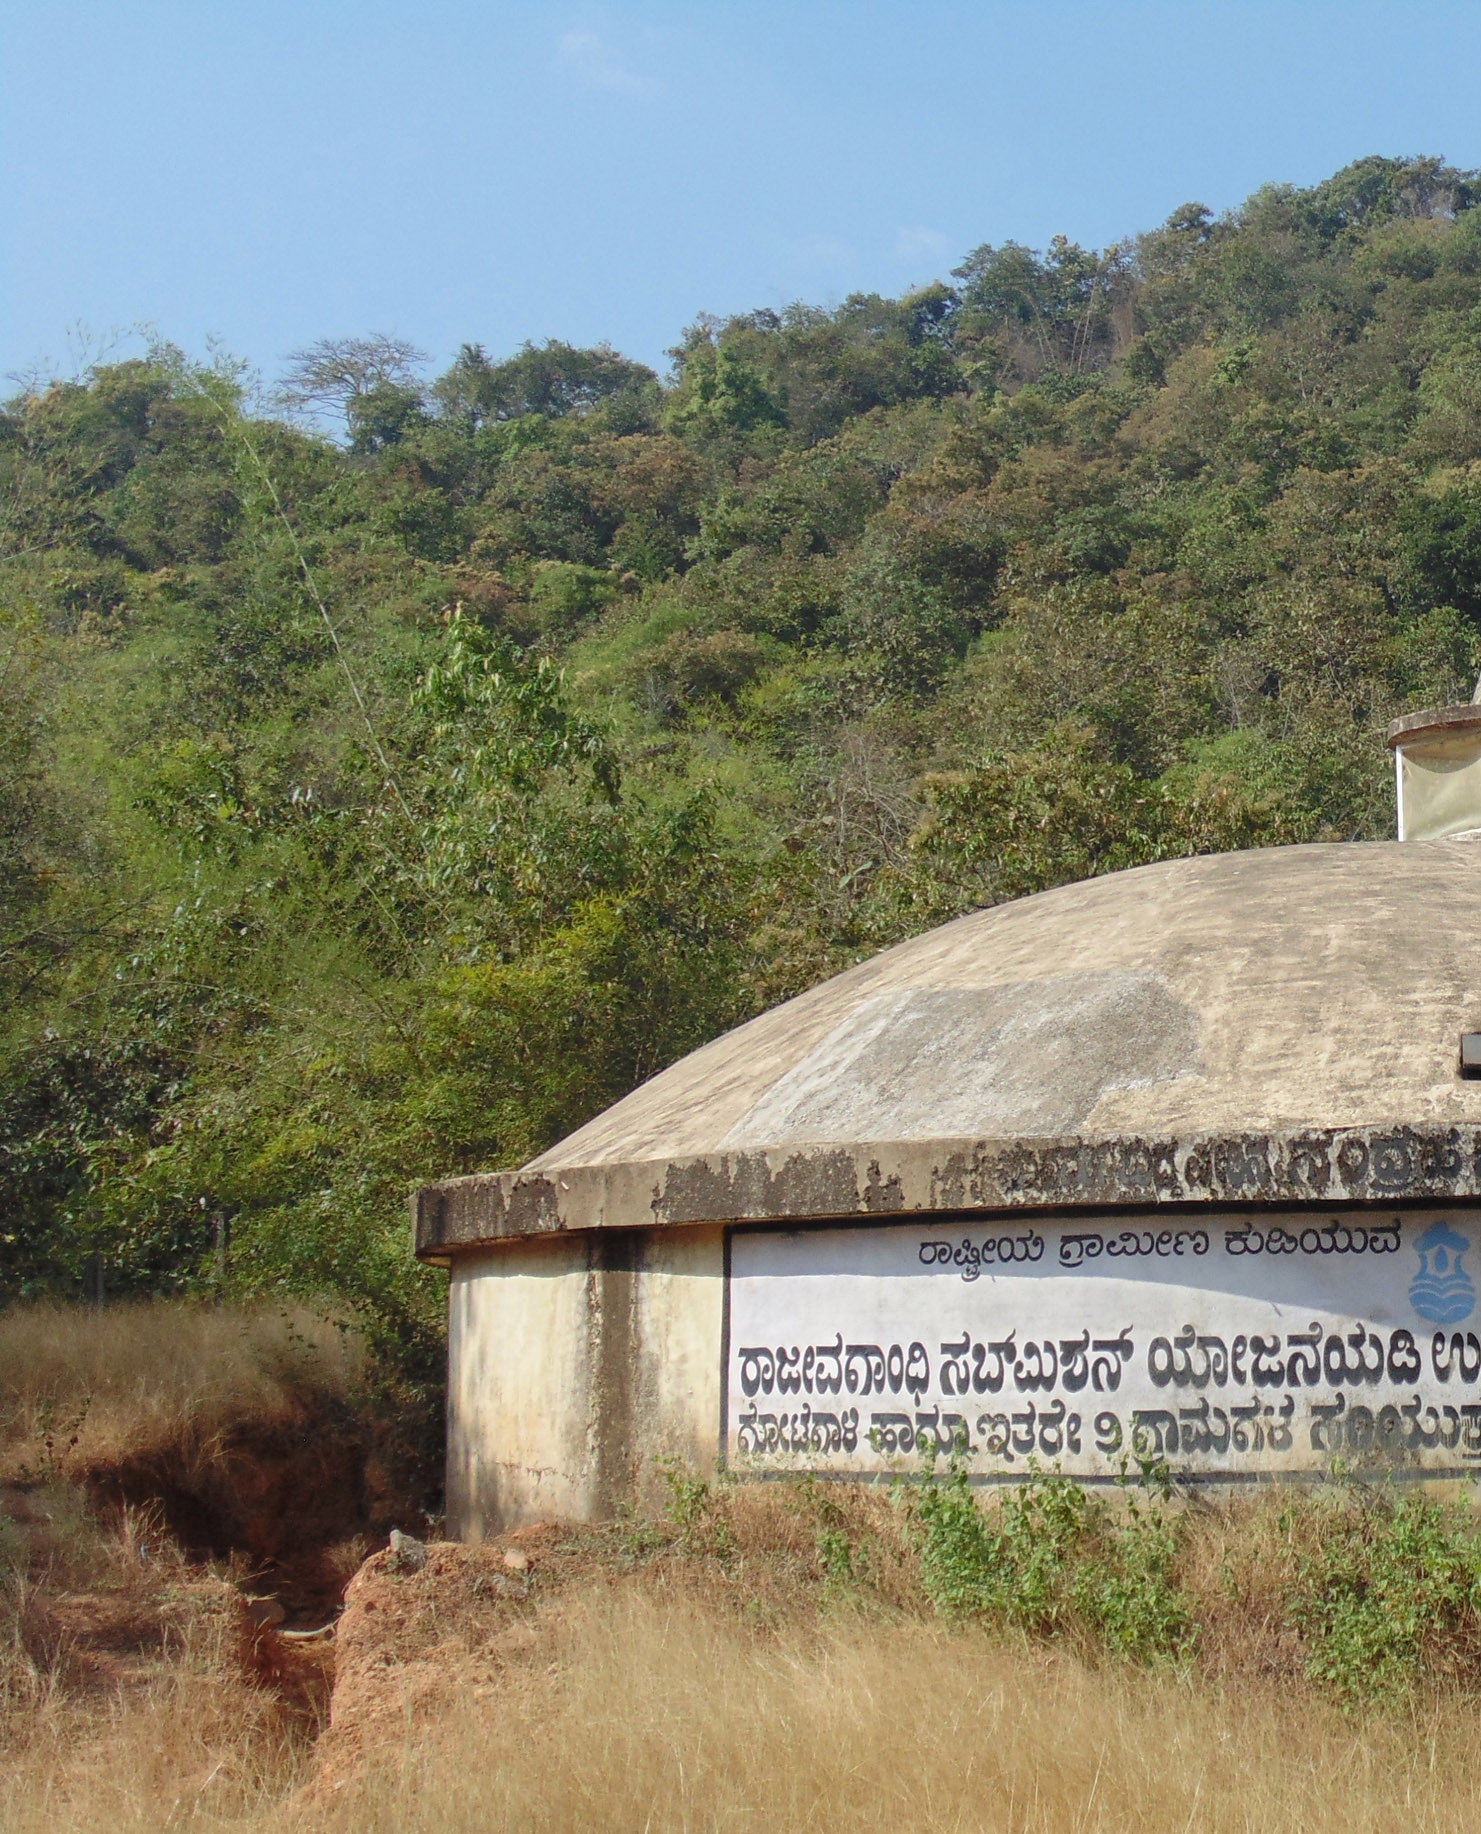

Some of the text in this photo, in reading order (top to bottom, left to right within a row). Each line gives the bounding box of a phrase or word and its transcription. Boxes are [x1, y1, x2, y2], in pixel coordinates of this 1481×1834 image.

[918, 1229, 1045, 1283] ರಾಷ್ಟ್ರೀಯ
[1058, 1228, 1210, 1267] ಗ್ರಾಮೀಣ
[1224, 1217, 1401, 1256] ಕುಡಿಯುವ
[738, 1332, 930, 1407] ರಾಜೀವಗಾಂಧಿ
[1147, 1321, 1421, 1389] ಯೋಜನೆಯಡಿ
